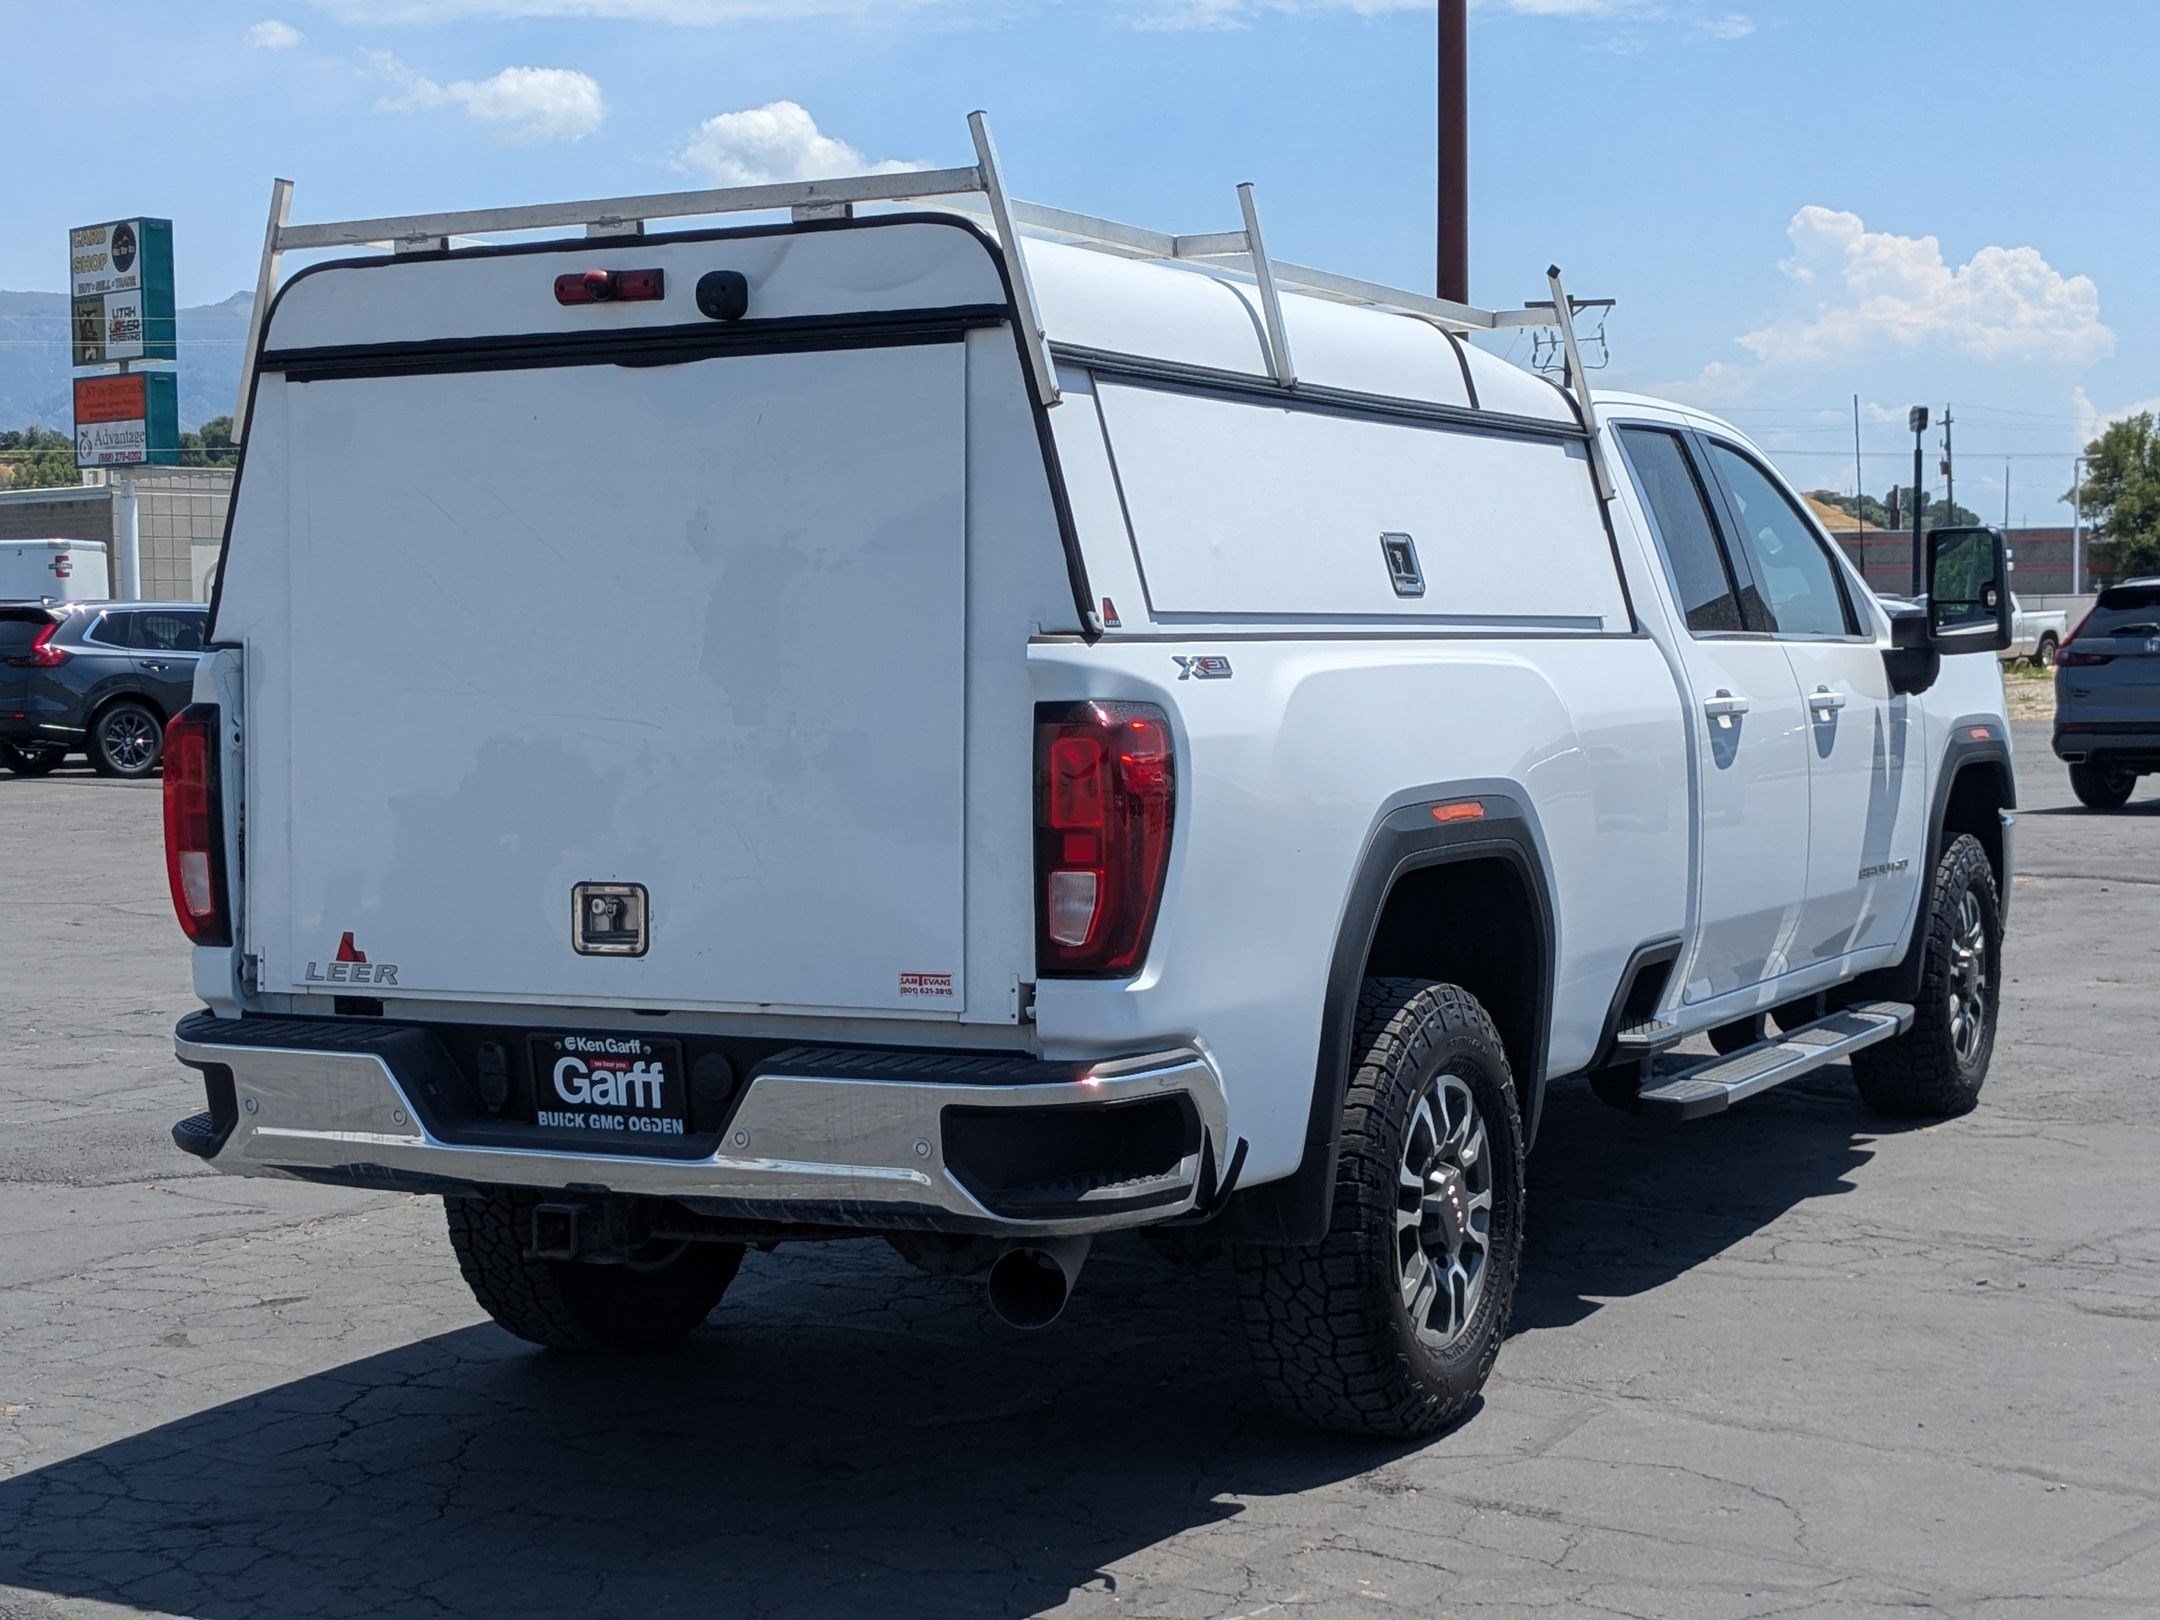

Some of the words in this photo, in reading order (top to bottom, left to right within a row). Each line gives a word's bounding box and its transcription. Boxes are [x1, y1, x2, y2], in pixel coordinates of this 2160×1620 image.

[73, 227, 106, 248] CARD
[73, 253, 107, 274] SHOP
[112, 306, 136, 318] UTAH
[109, 319, 140, 334] LASER
[94, 428, 145, 447] Advantage
[304, 961, 399, 986] LEER
[605, 1038, 641, 1054] Garff
[553, 1056, 665, 1109] Garff
[538, 1111, 586, 1128] BUICK
[589, 1114, 625, 1131] GMC
[628, 1116, 684, 1135] OGDEN
